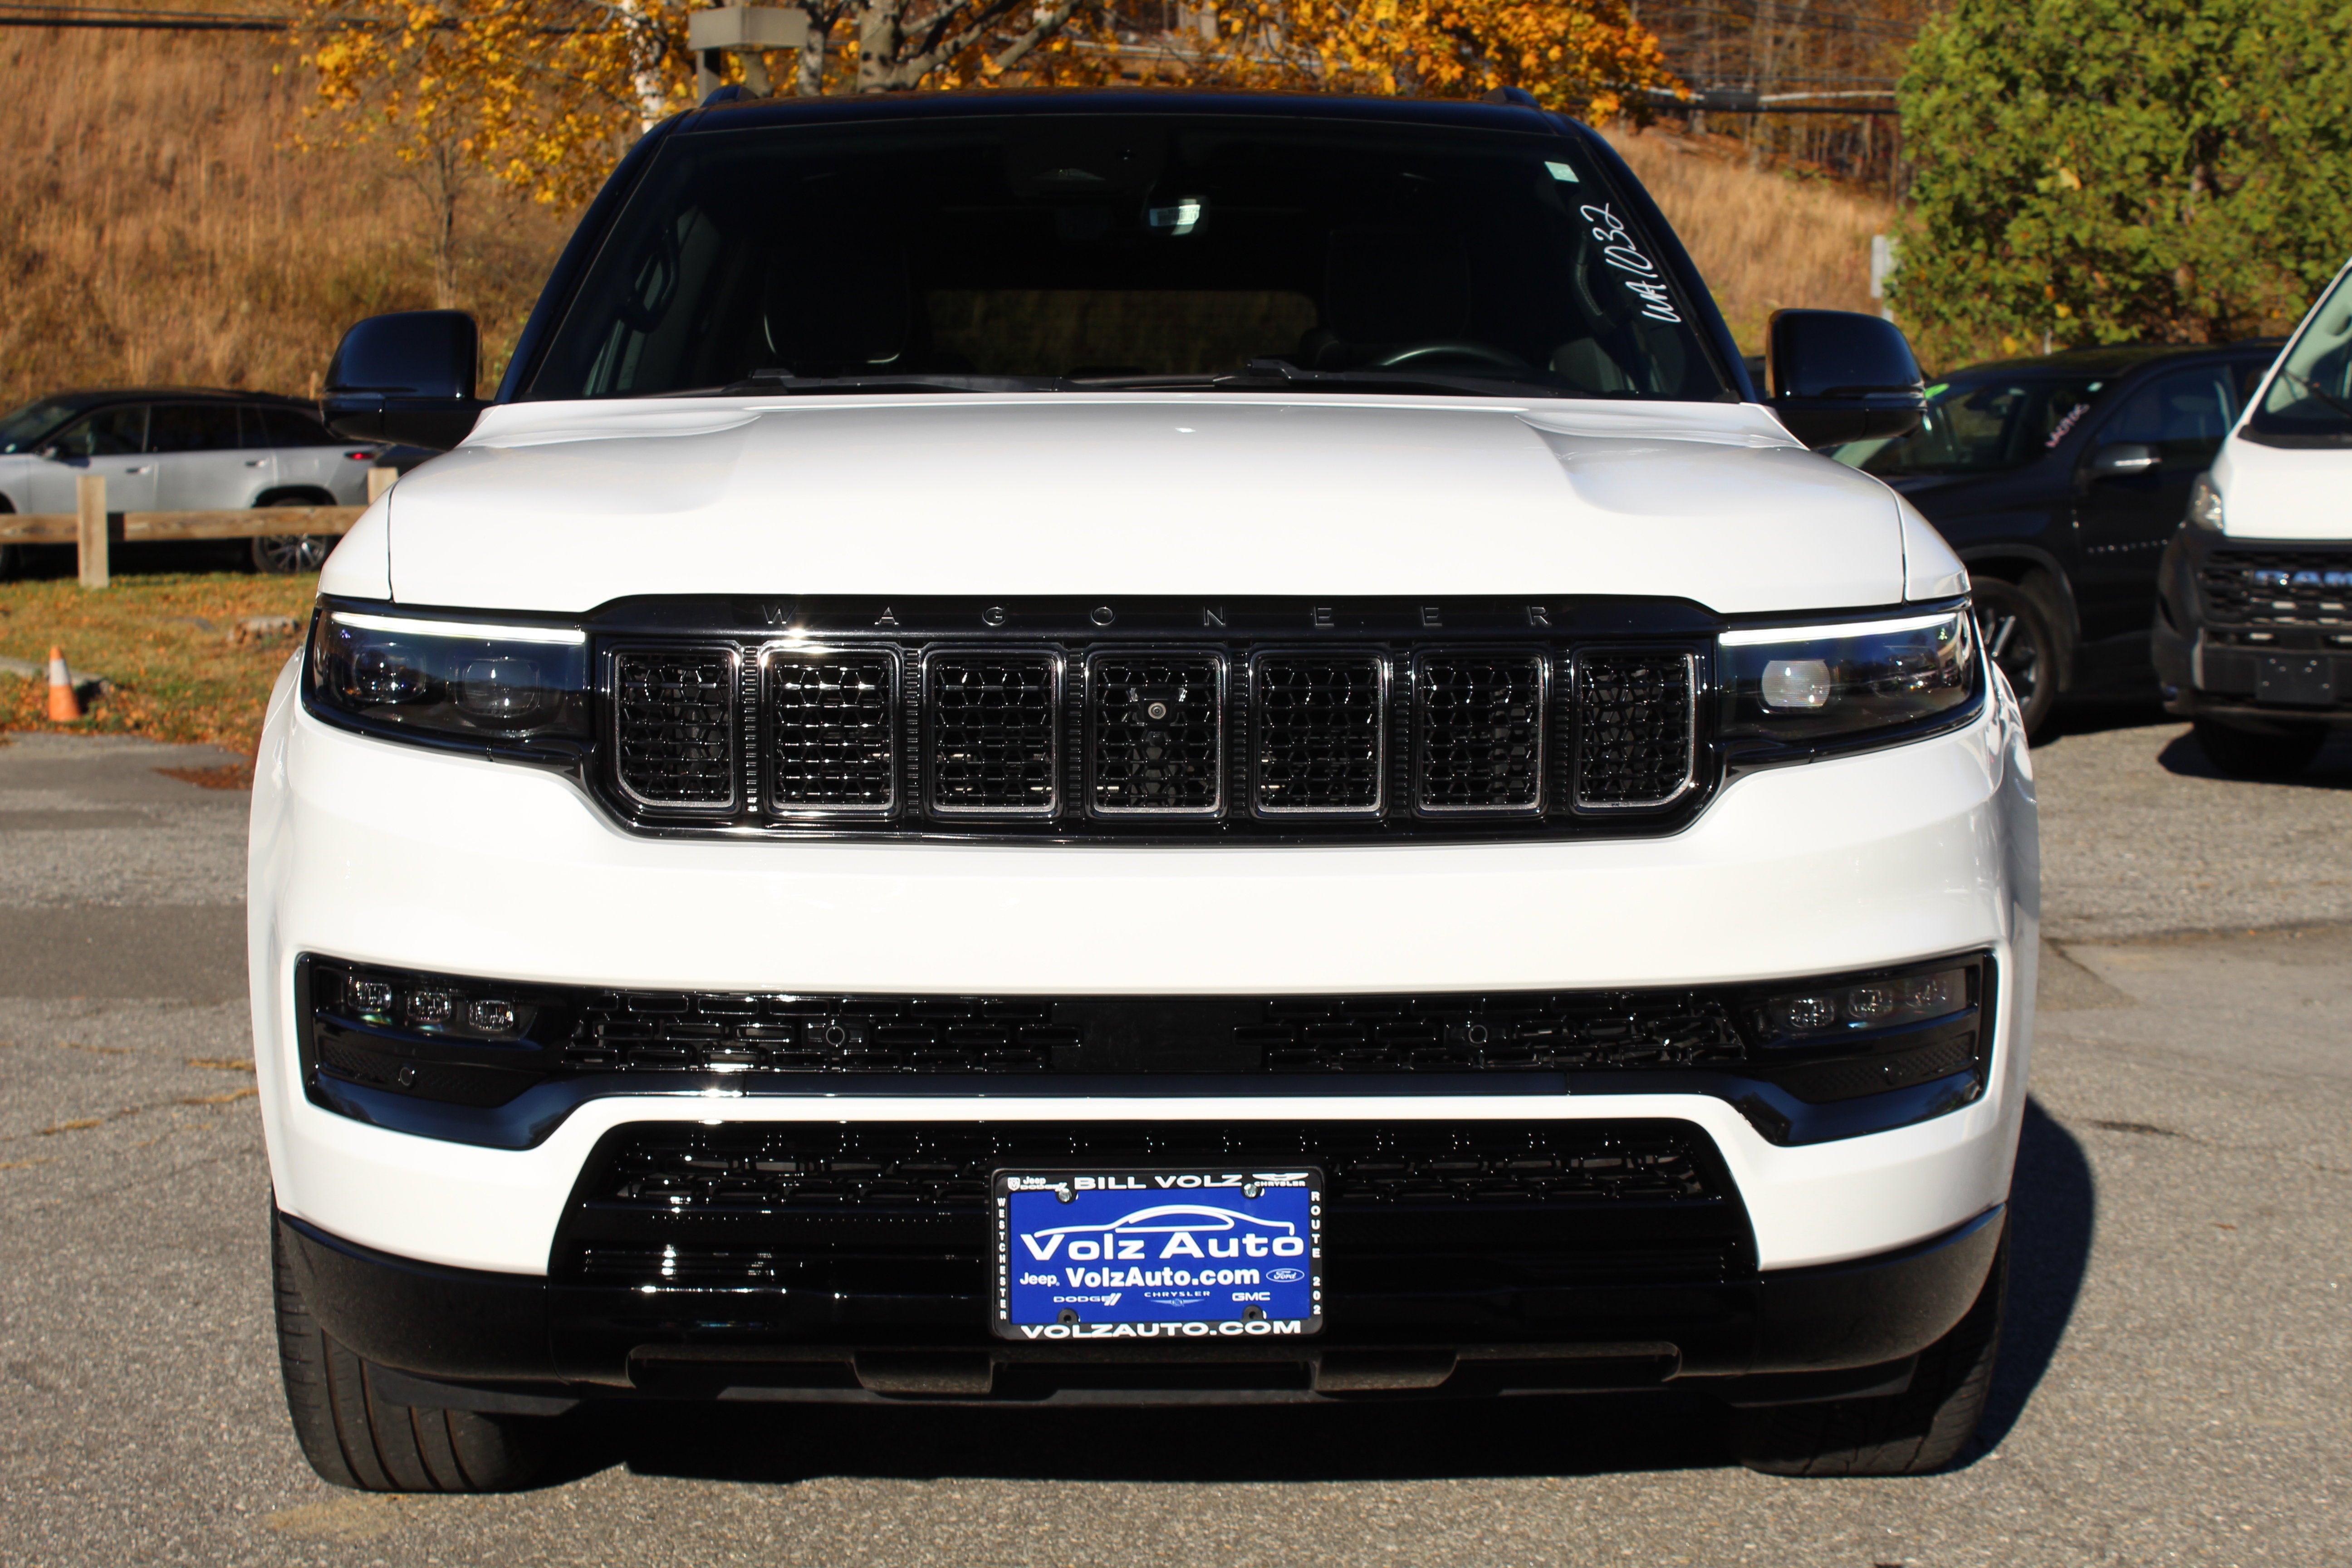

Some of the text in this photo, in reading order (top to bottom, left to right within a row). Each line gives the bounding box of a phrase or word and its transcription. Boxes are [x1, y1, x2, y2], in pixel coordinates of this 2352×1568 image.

[761, 604, 1553, 627] WAGONEER
[1023, 1176, 1046, 1185] Jeep
[1074, 1174, 1242, 1190] BILL VOLZ
[1020, 1231, 1304, 1261] Volz Auto
[1310, 1191, 1321, 1315] ROUTE 202
[997, 1197, 1006, 1319] WESTCHESTER
[1019, 1272, 1058, 1287] Jeep
[1065, 1266, 1260, 1288] VolzAuto.com
[1272, 1270, 1298, 1280] Ford
[1053, 1295, 1111, 1303] DODGE
[1232, 1292, 1270, 1301] GMC
[1020, 1320, 1301, 1339] VOLZAUTO.COM
